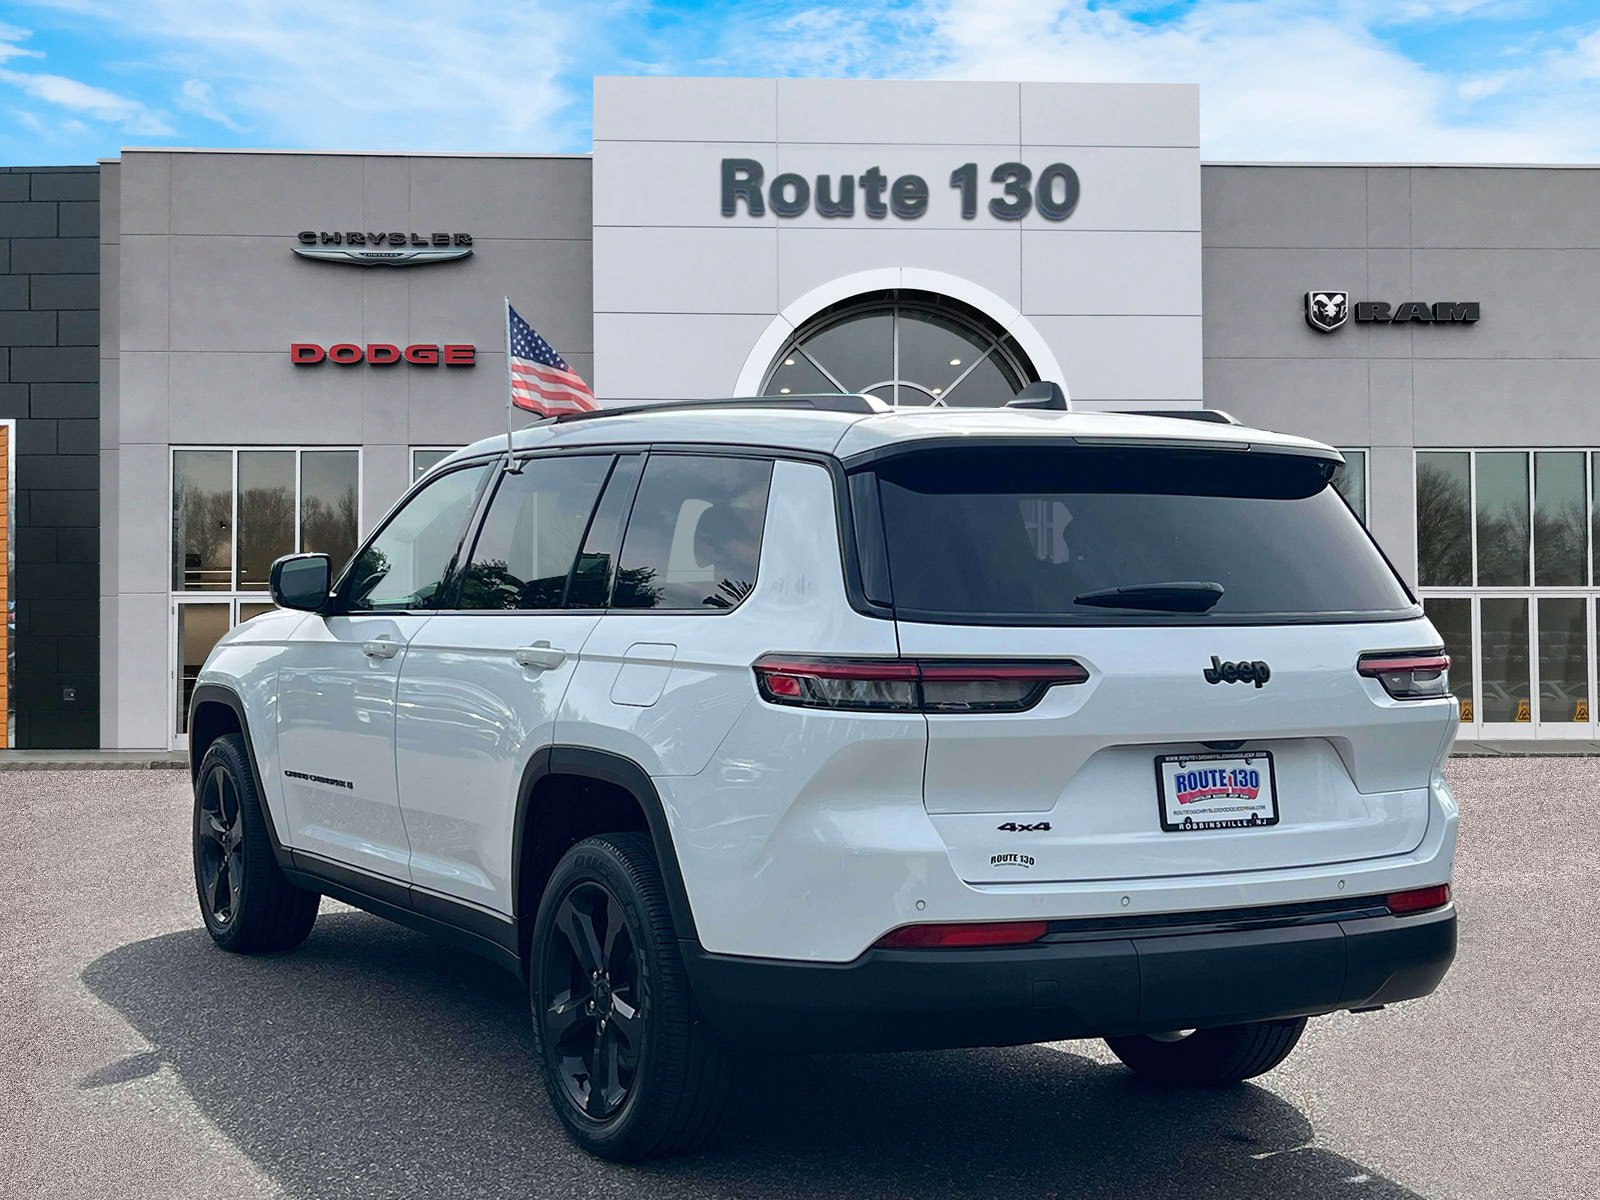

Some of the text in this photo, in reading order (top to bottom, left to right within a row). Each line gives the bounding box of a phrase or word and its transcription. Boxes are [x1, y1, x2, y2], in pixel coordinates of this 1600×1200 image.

[721, 158, 1080, 221] Route 130
[298, 231, 473, 246] CHRYSLER
[1355, 302, 1480, 323] RAM
[291, 343, 476, 366] DODGE
[1203, 656, 1271, 688] Jeep
[1175, 769, 1260, 793] ROUTE 130
[997, 822, 1052, 832] 4x4
[991, 854, 1035, 865] ROUTE 130
